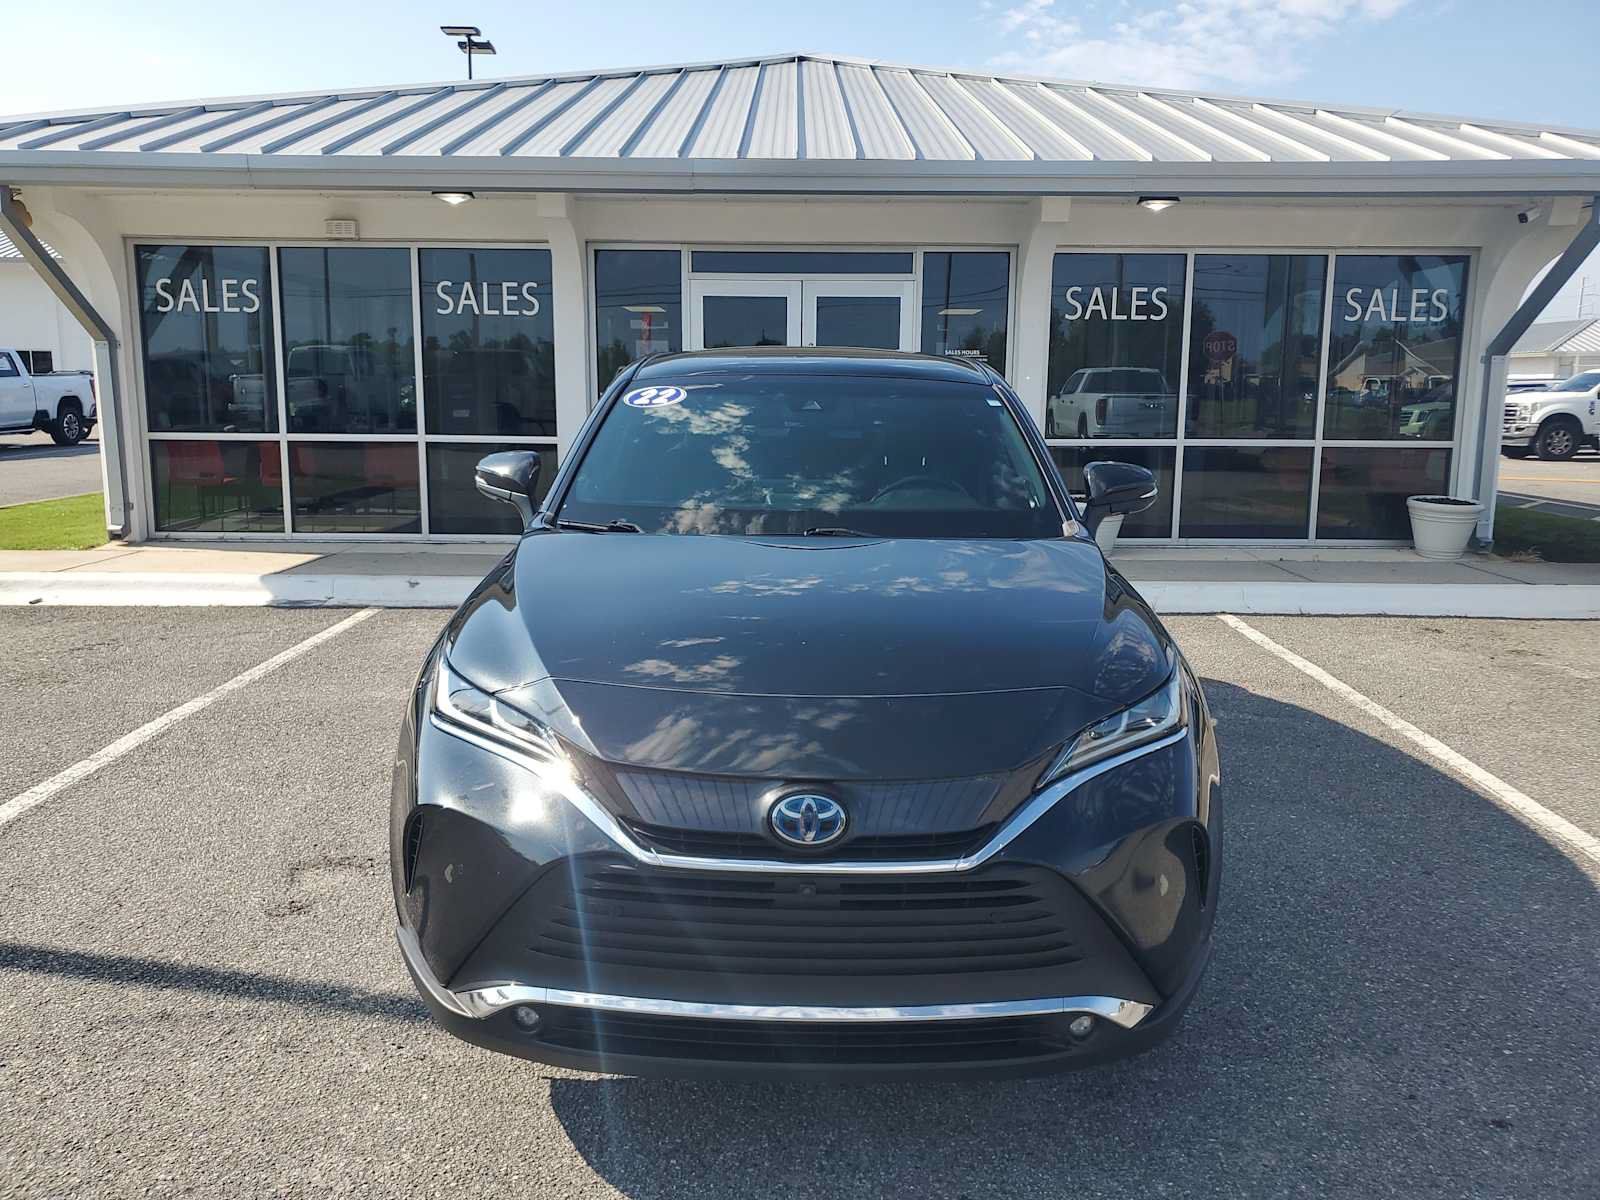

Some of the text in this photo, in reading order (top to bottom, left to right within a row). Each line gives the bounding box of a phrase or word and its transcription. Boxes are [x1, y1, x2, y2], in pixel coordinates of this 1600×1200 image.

[155, 278, 261, 313] SALES
[436, 281, 540, 316] SALES
[1064, 286, 1168, 321] SALES
[1344, 288, 1449, 321] SALES
[632, 388, 677, 405] 22
